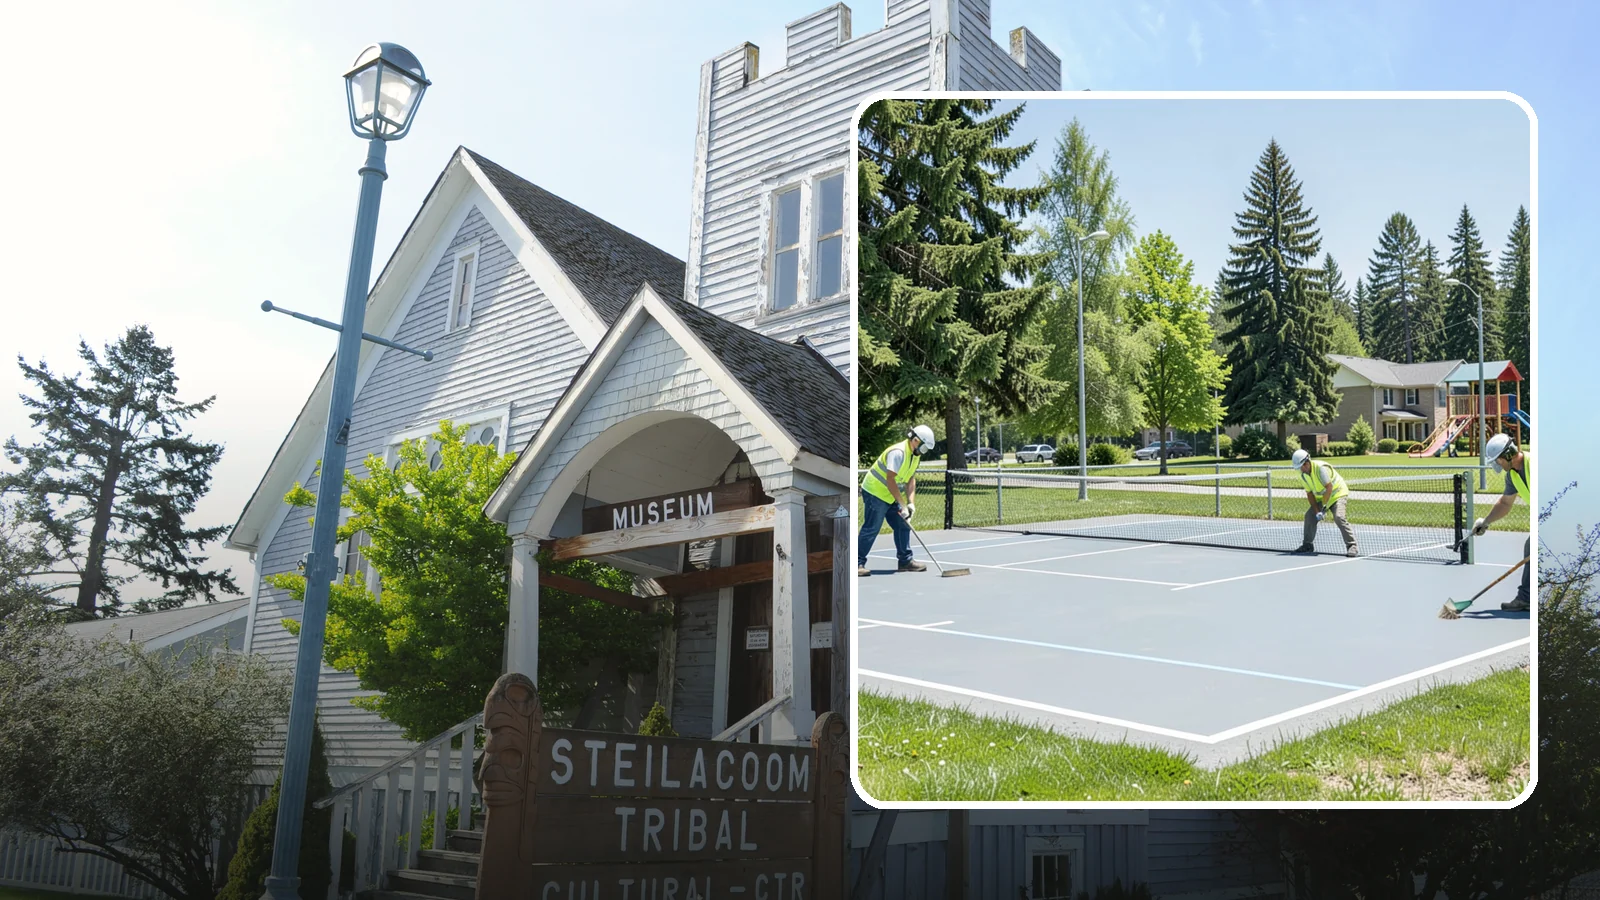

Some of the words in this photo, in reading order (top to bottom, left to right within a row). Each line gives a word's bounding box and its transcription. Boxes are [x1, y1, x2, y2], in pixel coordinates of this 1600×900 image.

[612, 491, 713, 530] MUSEUM
[550, 738, 809, 792] STEILACOOM
[615, 806, 757, 851] TRIBAL
